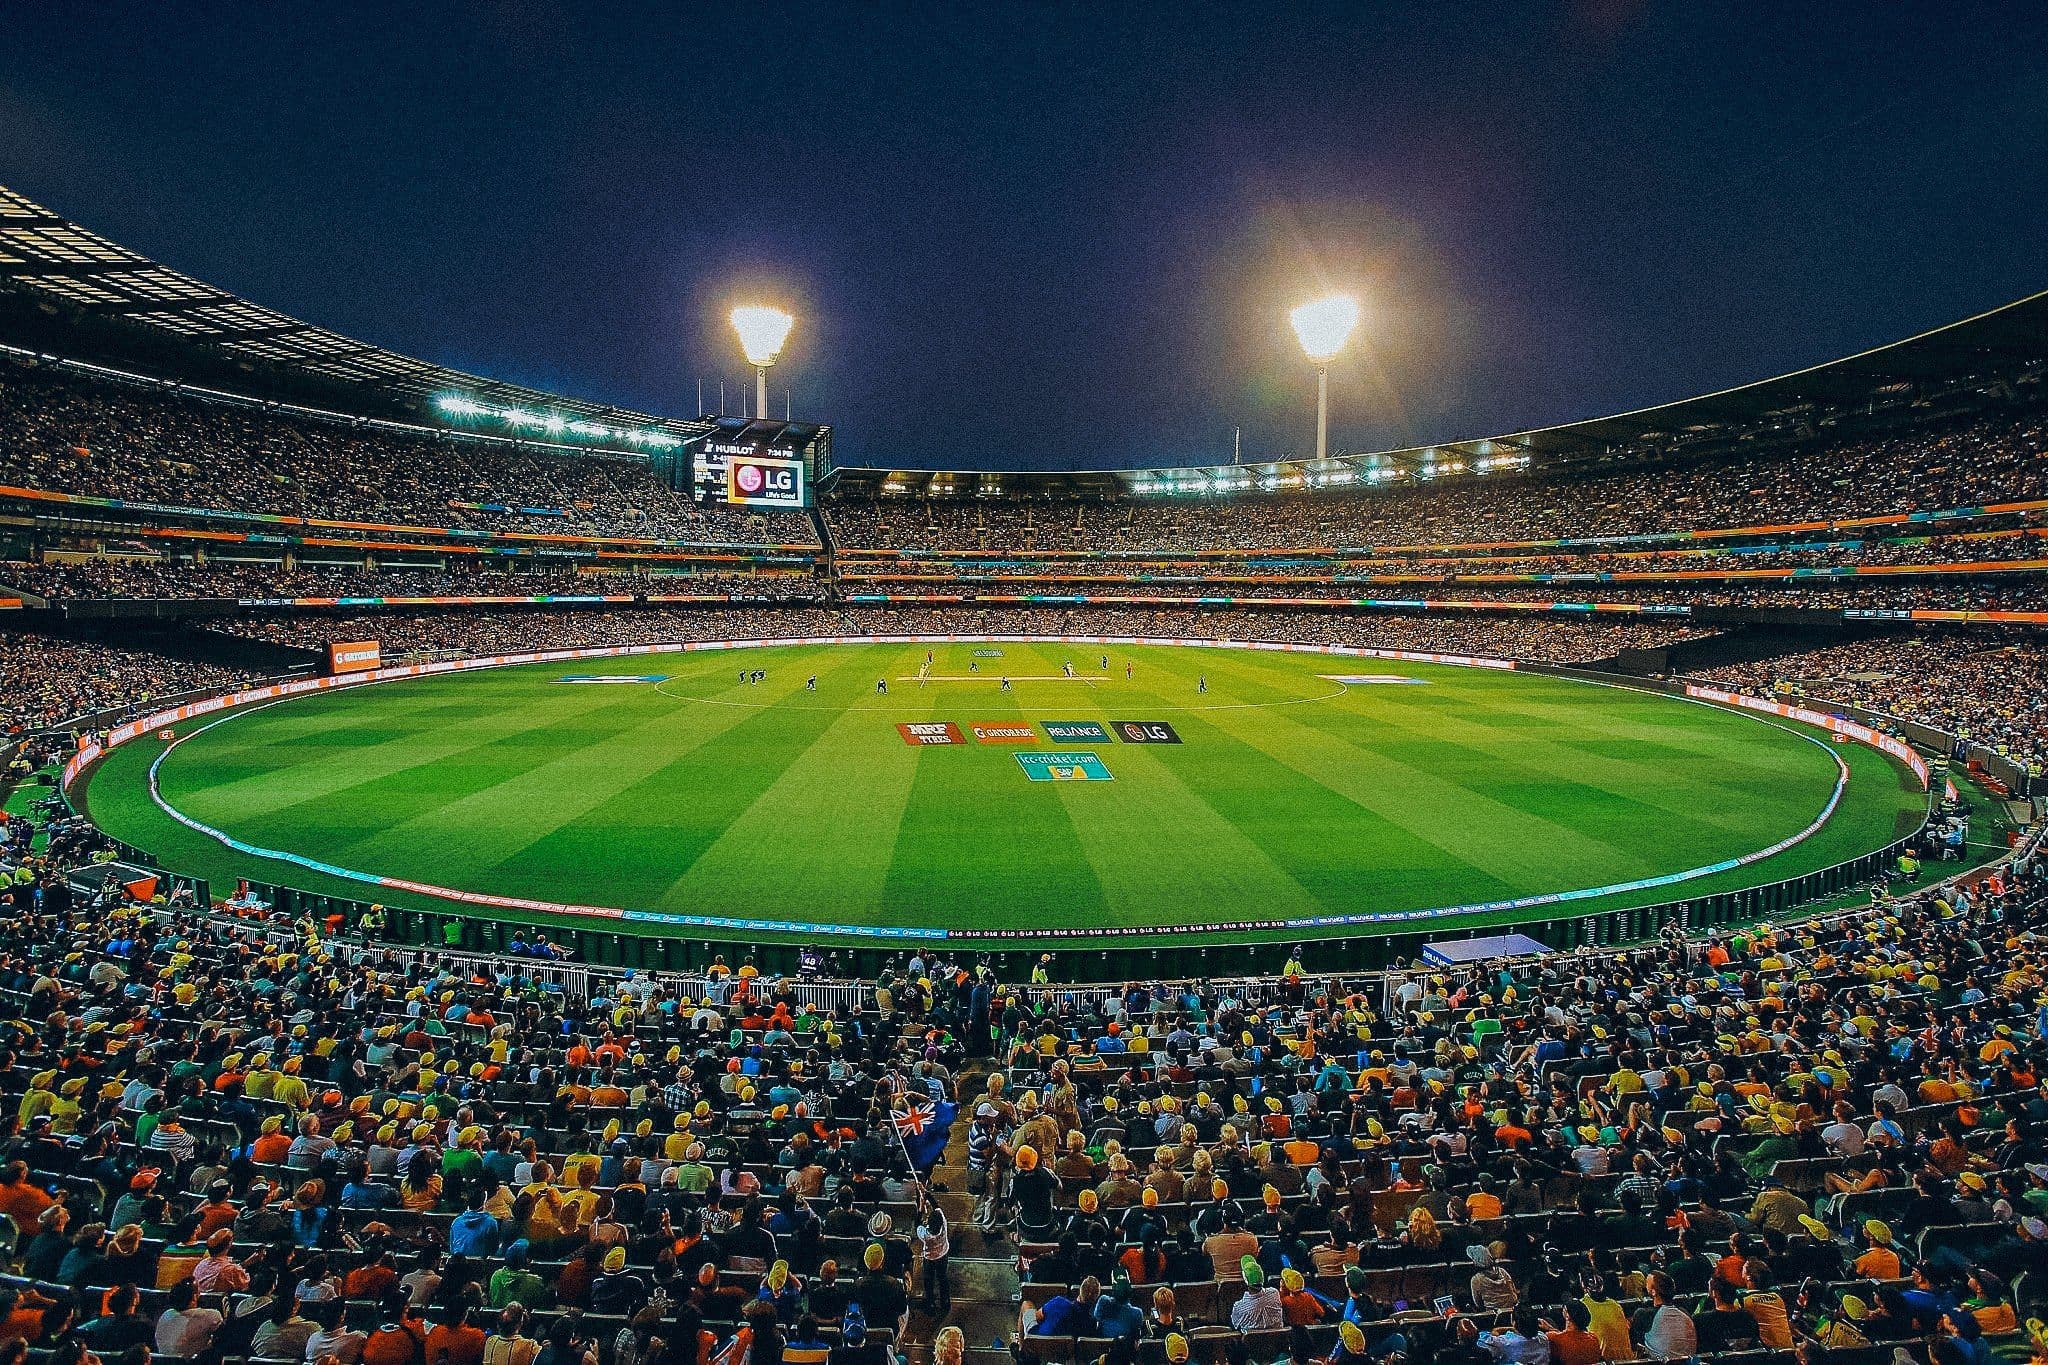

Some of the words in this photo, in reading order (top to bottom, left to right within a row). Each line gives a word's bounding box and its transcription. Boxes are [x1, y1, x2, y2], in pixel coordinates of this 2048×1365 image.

[715, 444, 754, 455] HUBLOT
[765, 470, 792, 490] LG
[765, 491, 780, 499] Life's
[780, 492, 796, 500] Good
[906, 723, 947, 735] MRF
[986, 728, 1036, 737] GATORADE
[1047, 727, 1102, 737] RELIANCE
[1142, 725, 1169, 740] LG
[918, 735, 952, 744] TYRES
[1020, 754, 1098, 764] icc-cricket.com
[1056, 768, 1073, 777] SAP
